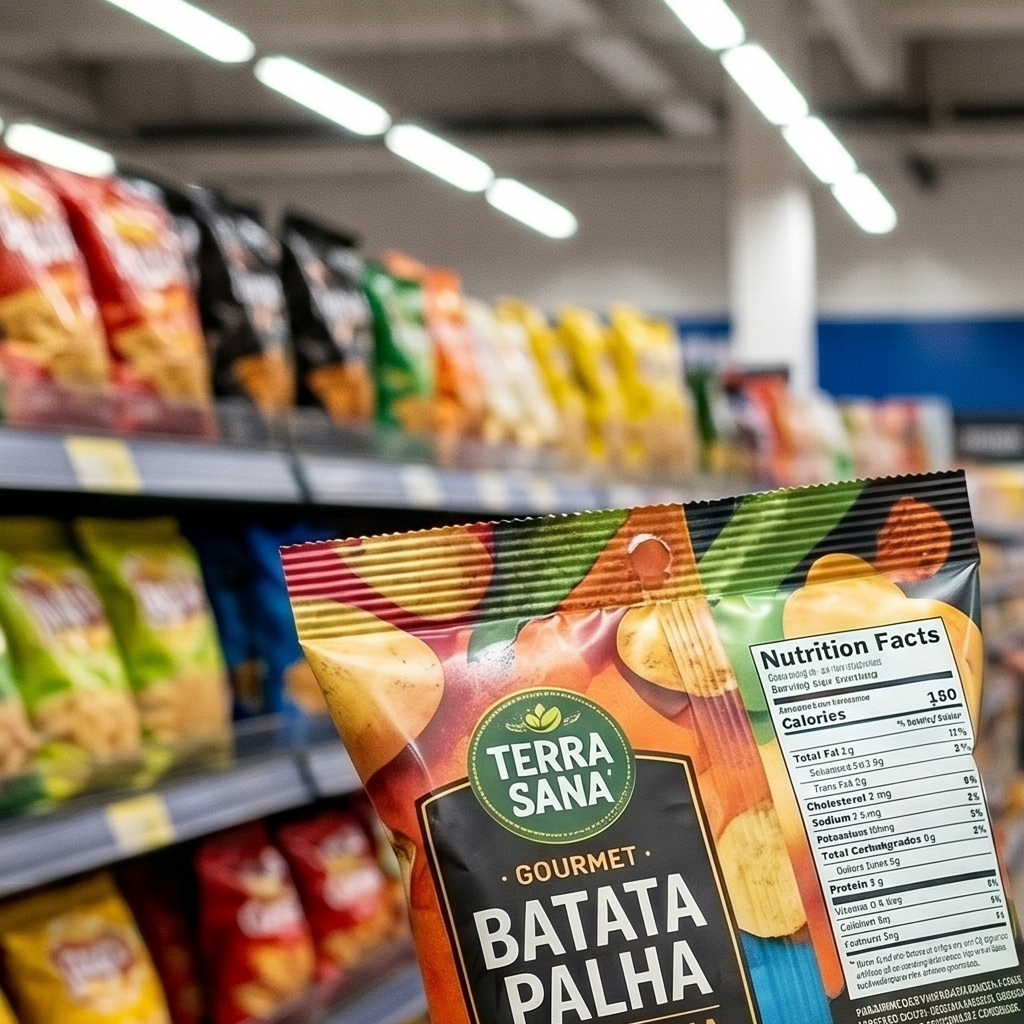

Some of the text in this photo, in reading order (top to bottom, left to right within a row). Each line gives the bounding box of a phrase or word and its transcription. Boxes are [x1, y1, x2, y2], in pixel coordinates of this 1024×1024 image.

[760, 628, 940, 669] Nutrition Facts
[782, 710, 846, 729] Calories
[486, 731, 615, 781] TERRA
[793, 751, 821, 763] Total
[812, 815, 851, 827] Sodium
[515, 846, 637, 886] GOURMET
[830, 880, 868, 894] Protein
[473, 873, 708, 971] BATATA
